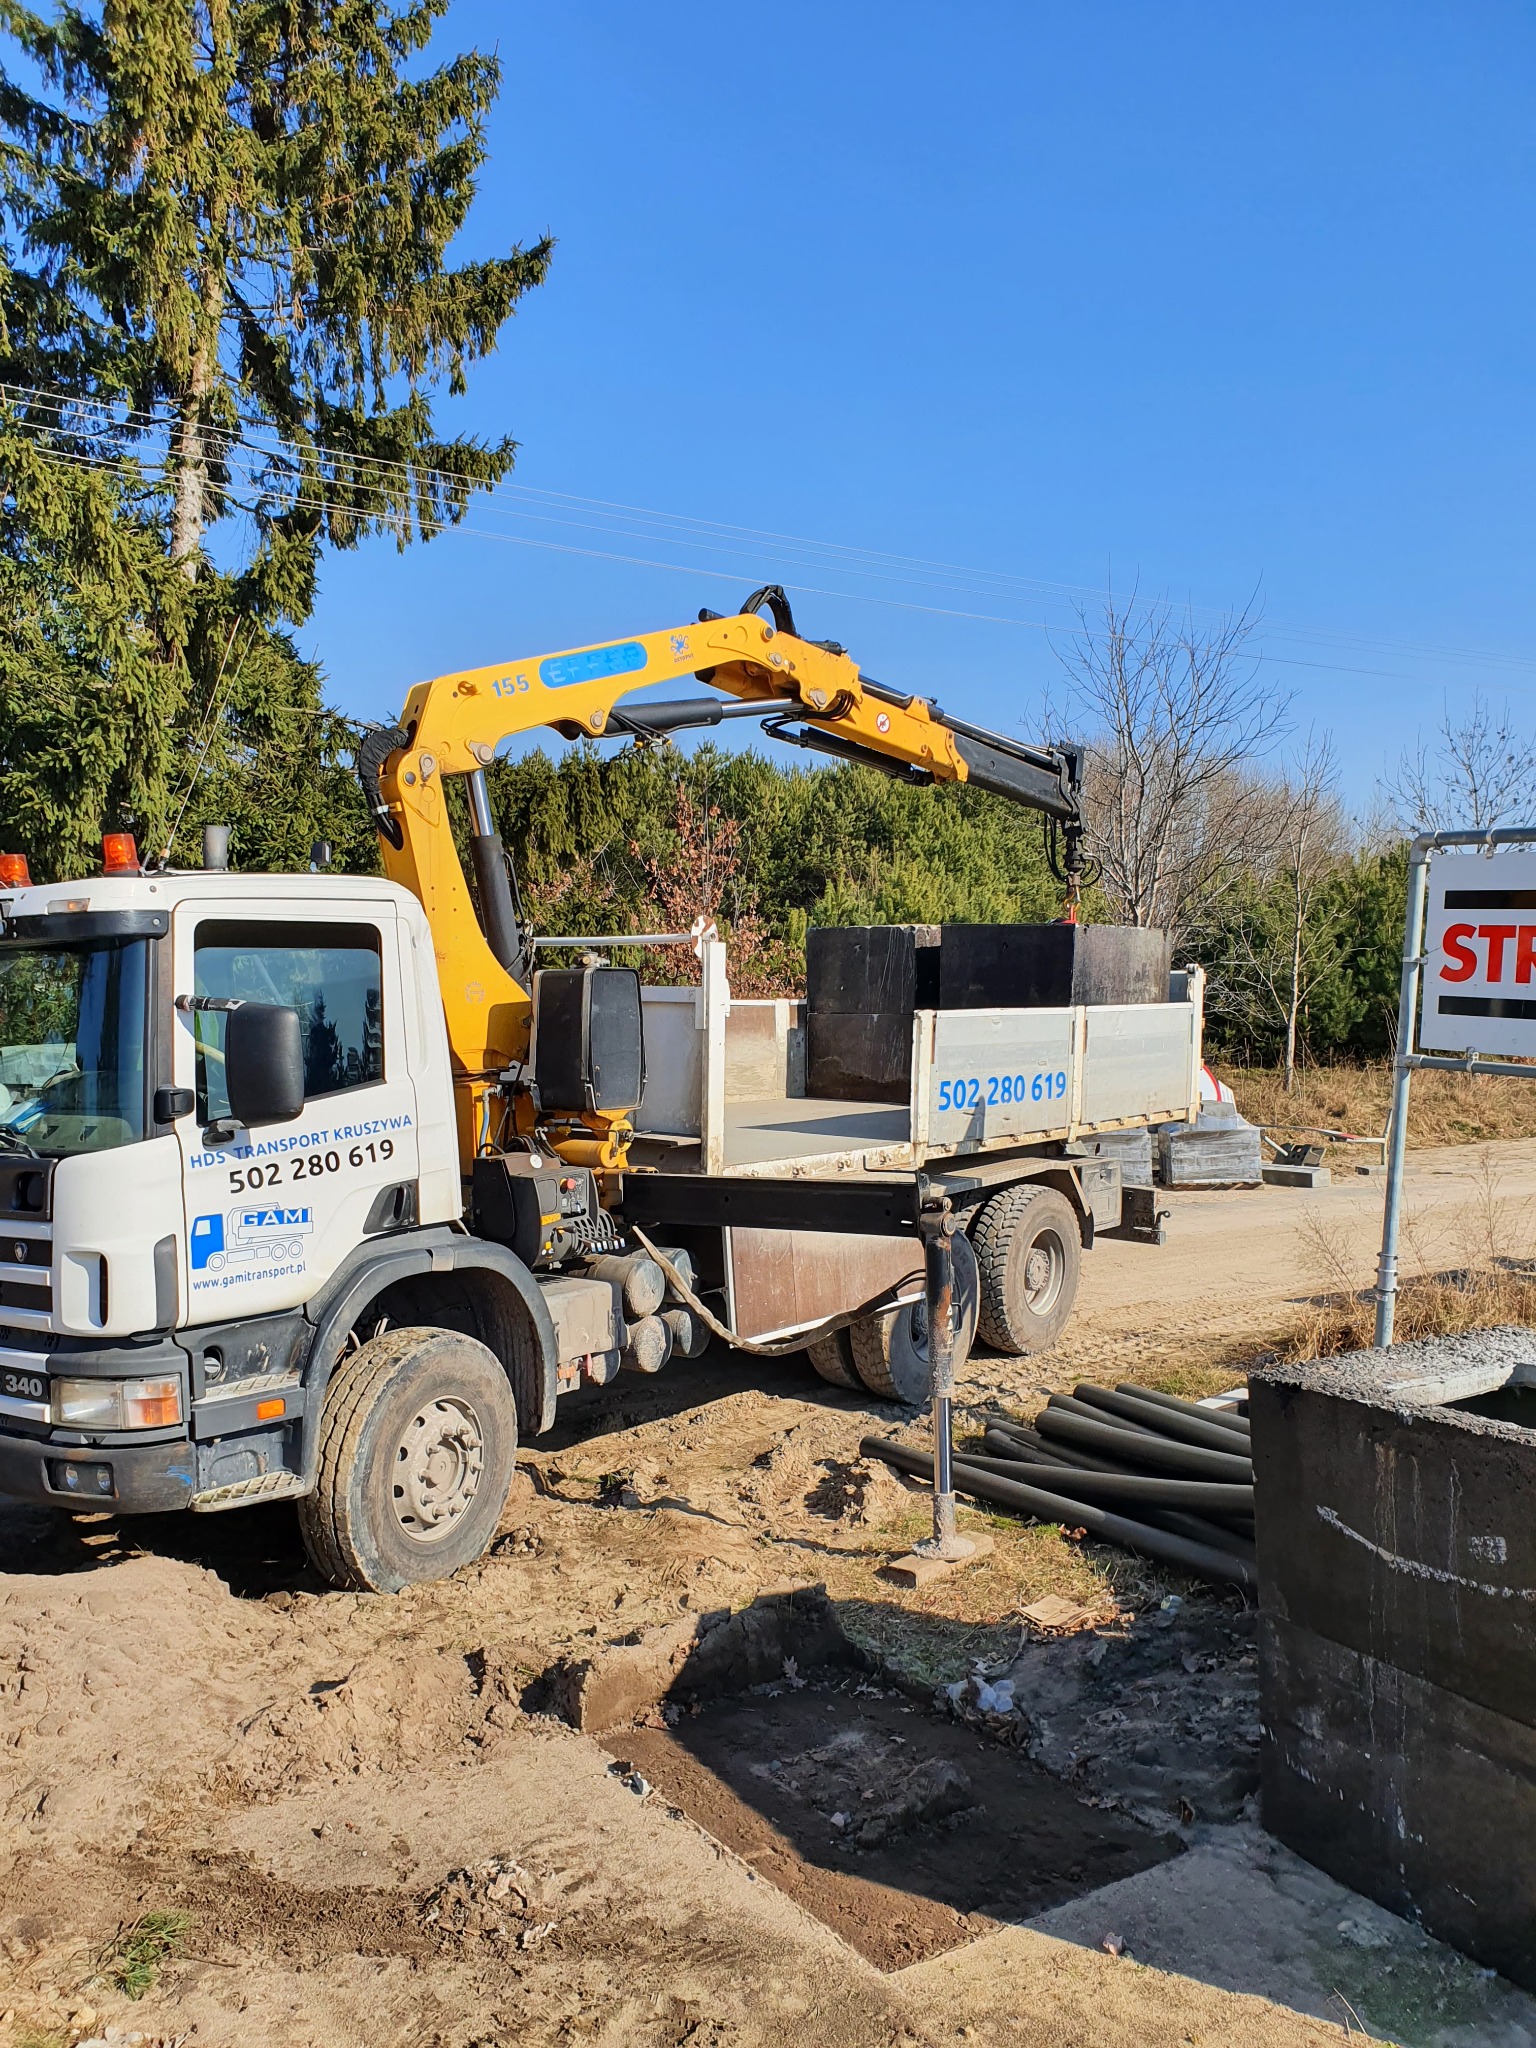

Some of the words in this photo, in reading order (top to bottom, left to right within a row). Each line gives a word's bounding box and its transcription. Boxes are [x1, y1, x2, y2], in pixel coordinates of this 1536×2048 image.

[491, 674, 530, 698] 155
[938, 1078, 980, 1111] 502
[987, 1075, 1025, 1105] 280
[1031, 1071, 1066, 1101] 619
[190, 1150, 226, 1168] HDS
[234, 1130, 329, 1160] TRANSPORT
[333, 1115, 412, 1141] KRUSZYWA
[229, 1163, 282, 1194] 502
[290, 1150, 341, 1181] 280
[348, 1139, 394, 1167] 619
[240, 1207, 312, 1226] GAMI
[193, 1261, 306, 1290] www.gamitransport.pl
[5, 1374, 43, 1397] 340
